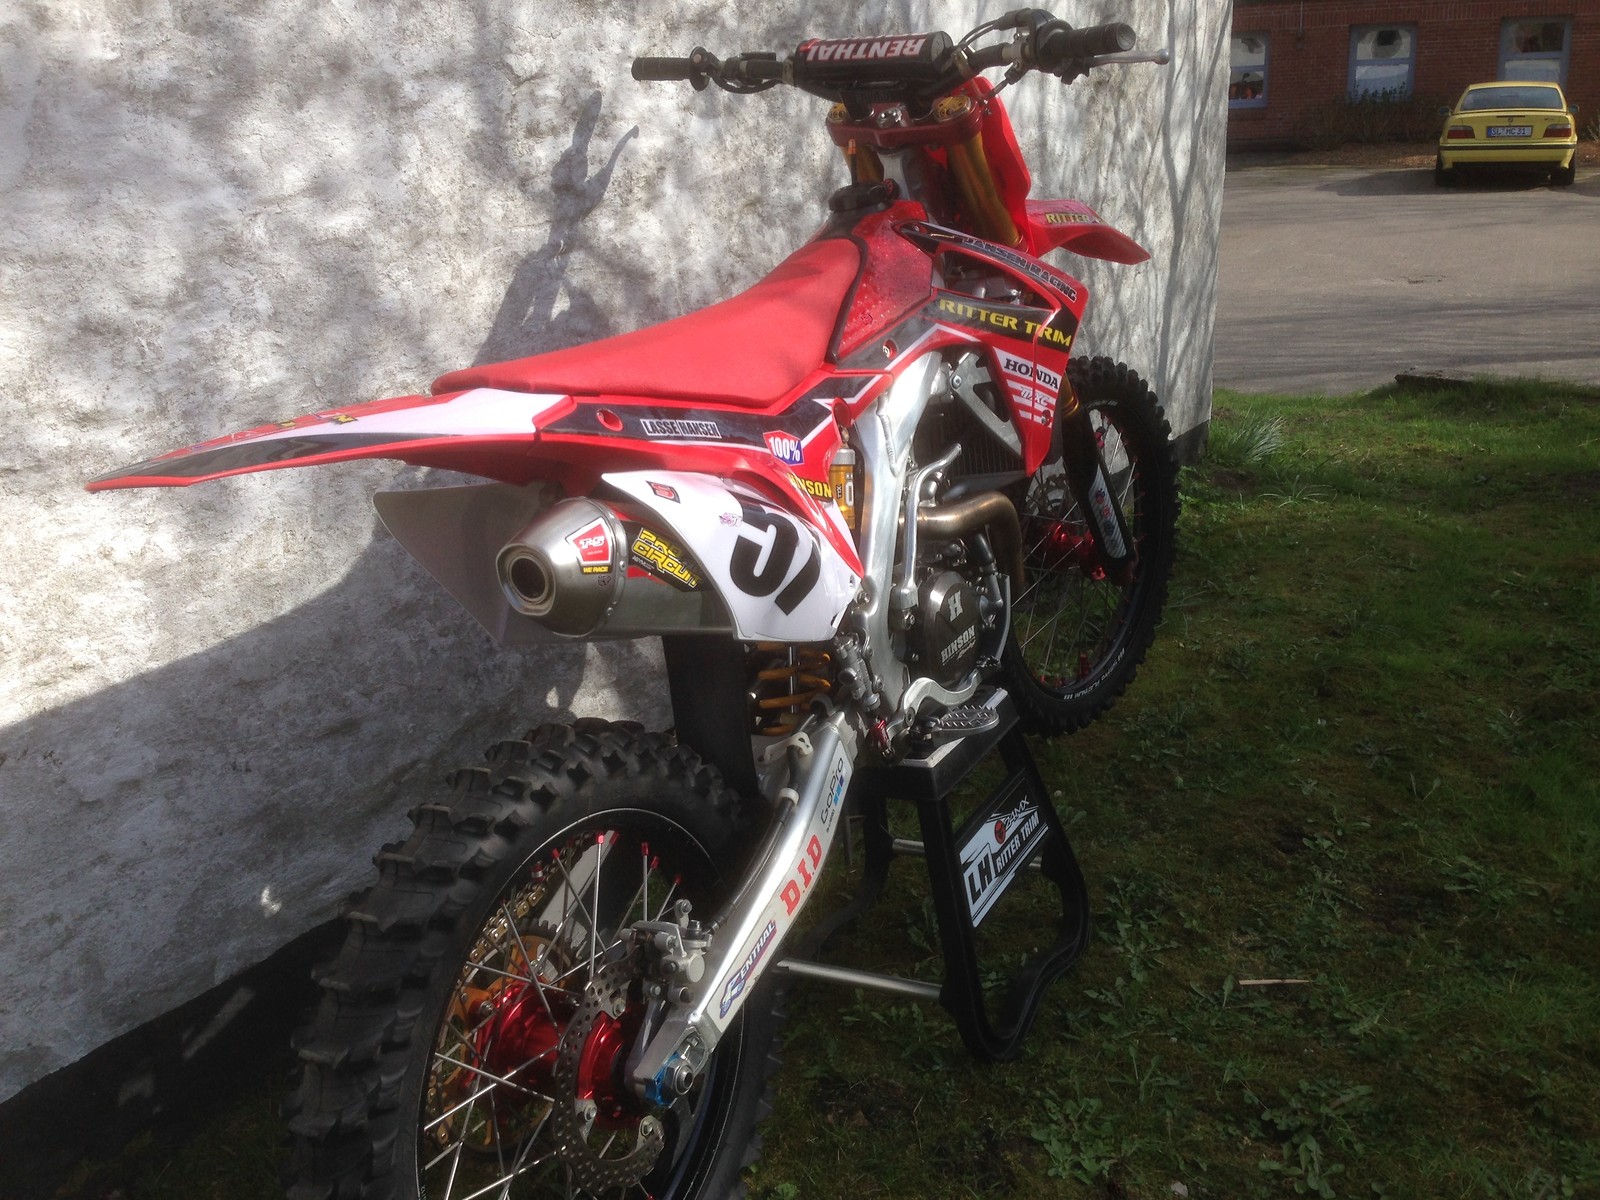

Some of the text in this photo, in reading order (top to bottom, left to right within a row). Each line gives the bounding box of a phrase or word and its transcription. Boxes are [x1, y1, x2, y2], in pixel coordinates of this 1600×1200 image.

[1046, 213, 1091, 224] RITTER
[939, 299, 1072, 347] RITTER TRIM
[1004, 358, 1059, 390] HONDA
[642, 420, 721, 438] LASSE HANSEN
[769, 436, 801, 462] 100%
[632, 539, 701, 588] CIRCUIT
[947, 590, 963, 622] H
[941, 625, 975, 663] HINSON
[821, 757, 844, 825] GoPro
[995, 811, 1040, 873] RITTER TRIM
[968, 851, 993, 906] LH
